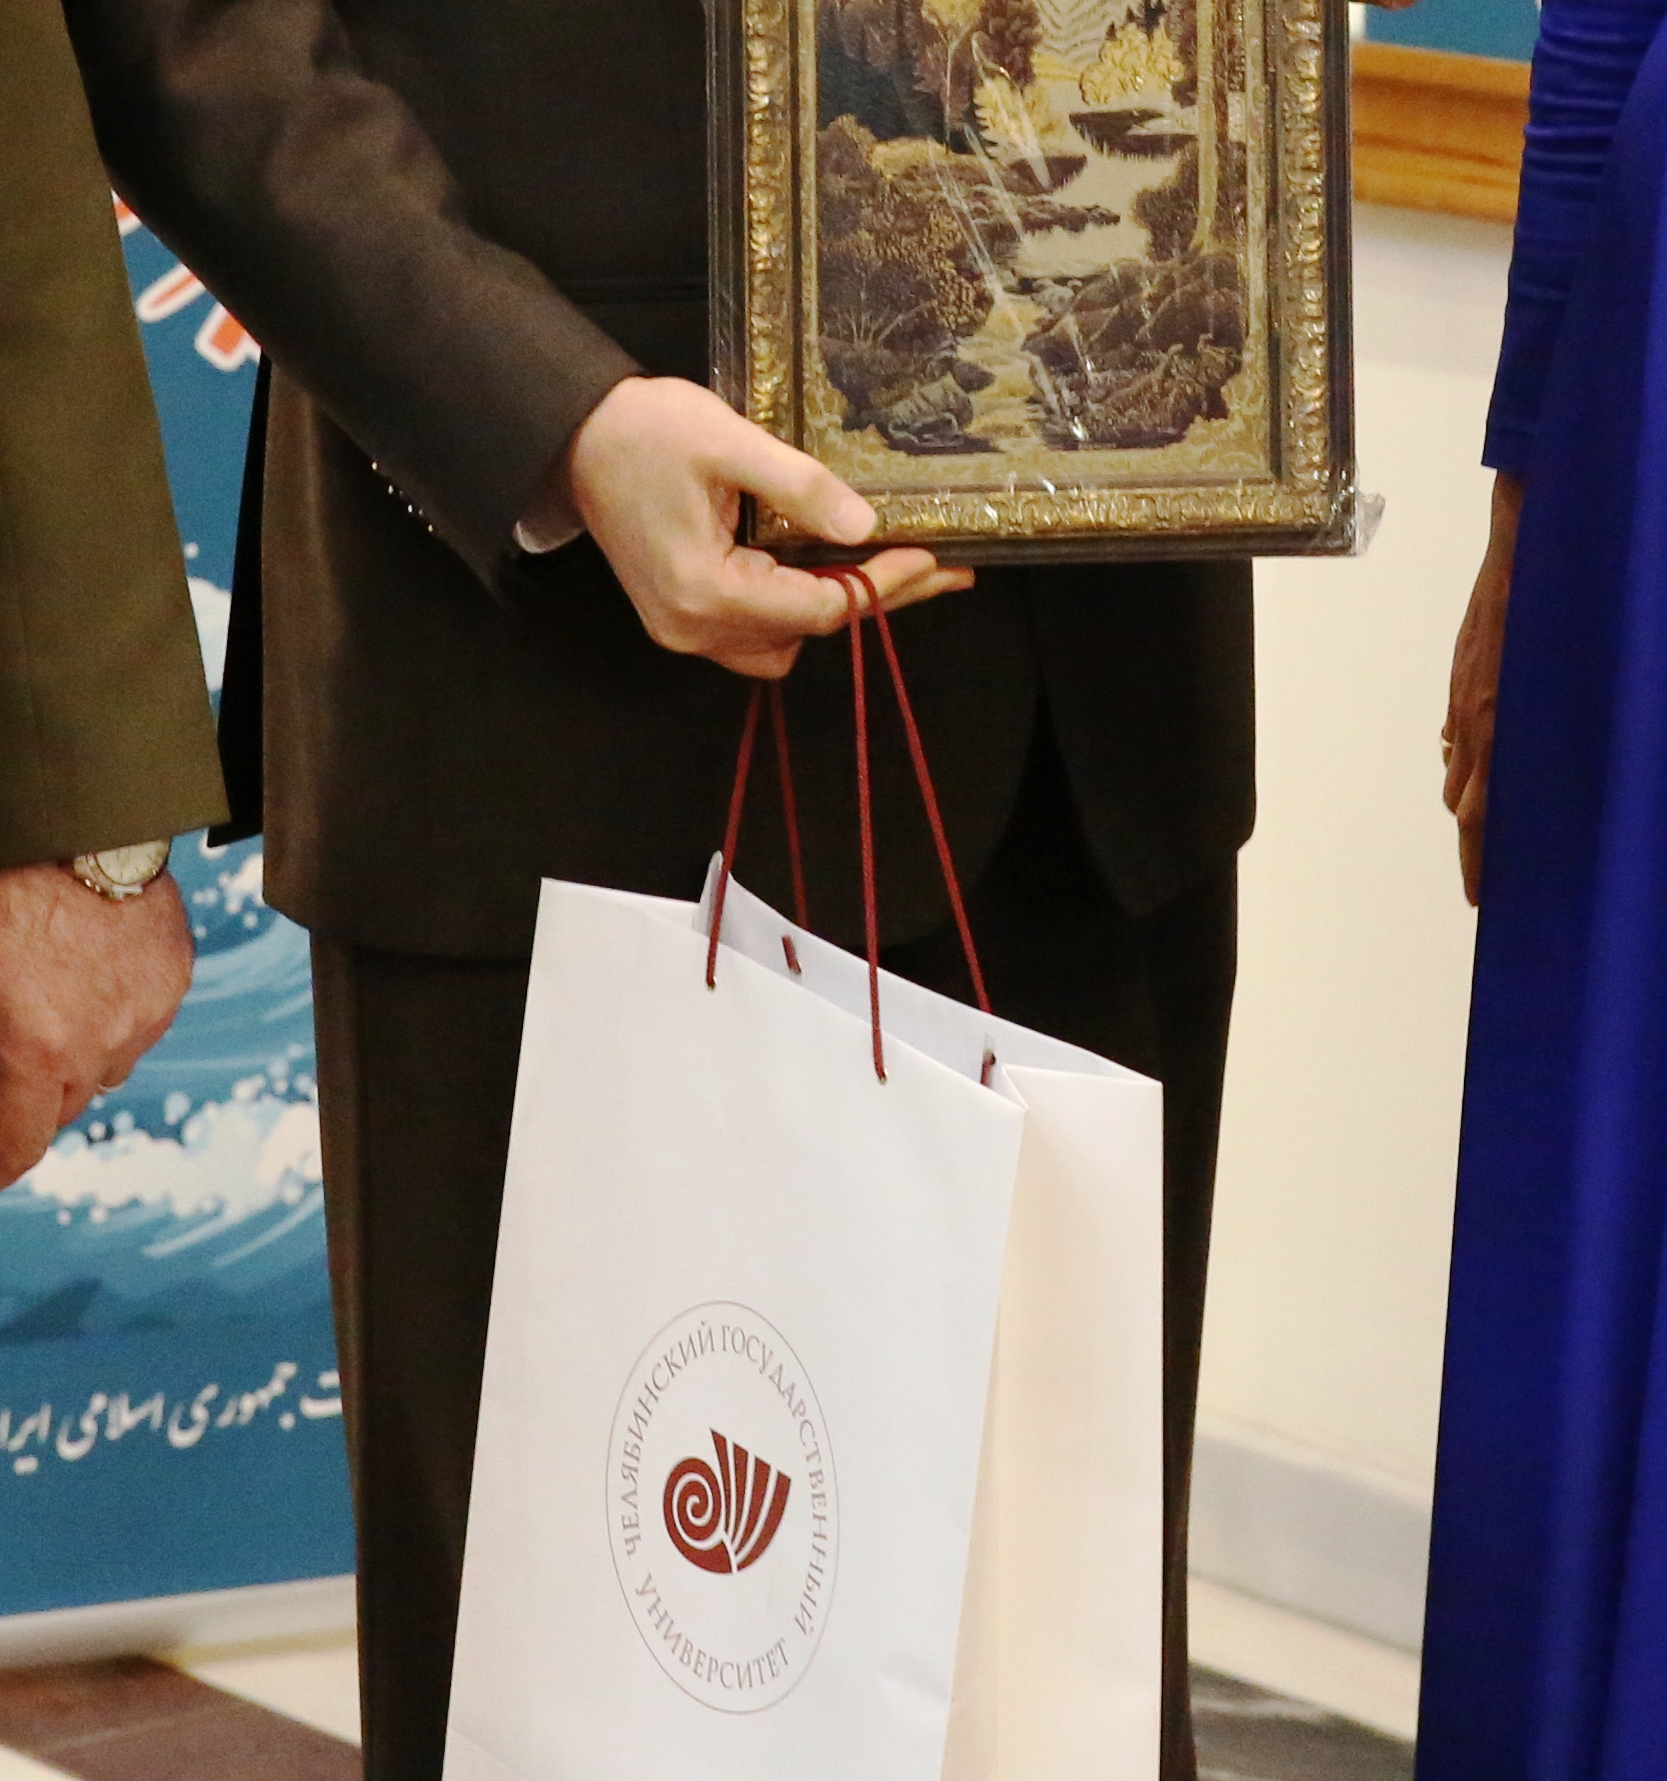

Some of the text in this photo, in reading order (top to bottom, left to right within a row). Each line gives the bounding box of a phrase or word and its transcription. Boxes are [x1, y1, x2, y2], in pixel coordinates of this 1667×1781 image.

[619, 1320, 828, 1637] ЧЕЛЯБИНСКИЙ ГОСУДАРСТВЕННЫЙ
[635, 1572, 789, 1690] УНИВЕРСИТЕТ
